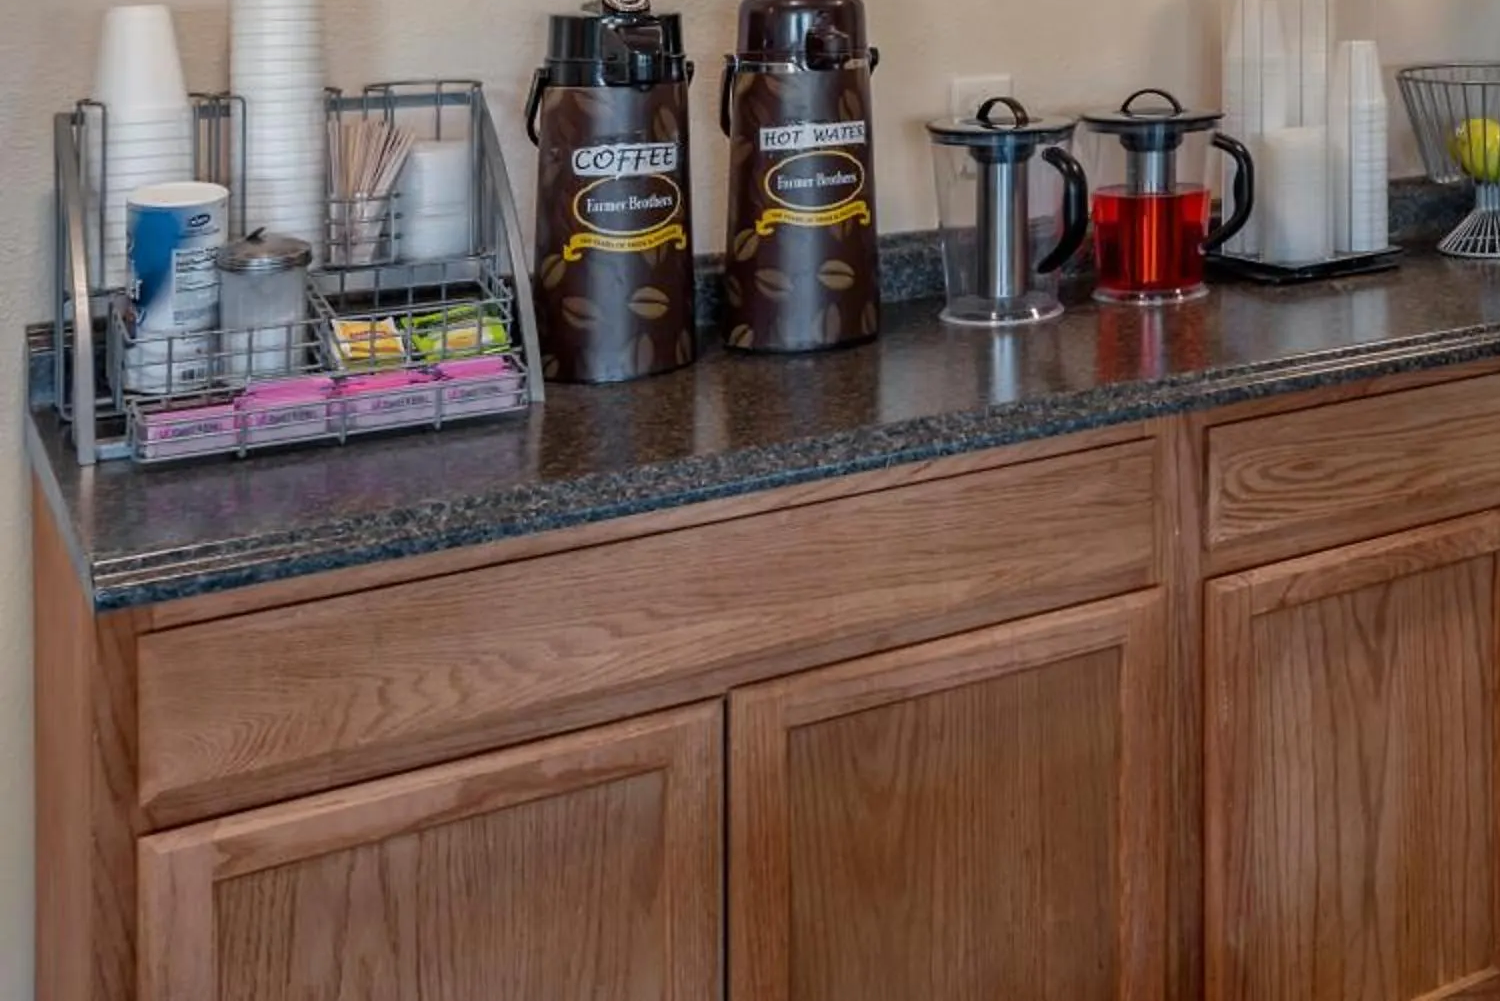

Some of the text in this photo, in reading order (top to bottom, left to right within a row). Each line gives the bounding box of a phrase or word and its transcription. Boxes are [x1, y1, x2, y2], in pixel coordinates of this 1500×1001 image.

[763, 130, 803, 147] HOT
[575, 146, 674, 172] COFFEE
[629, 194, 673, 210] Brothers
